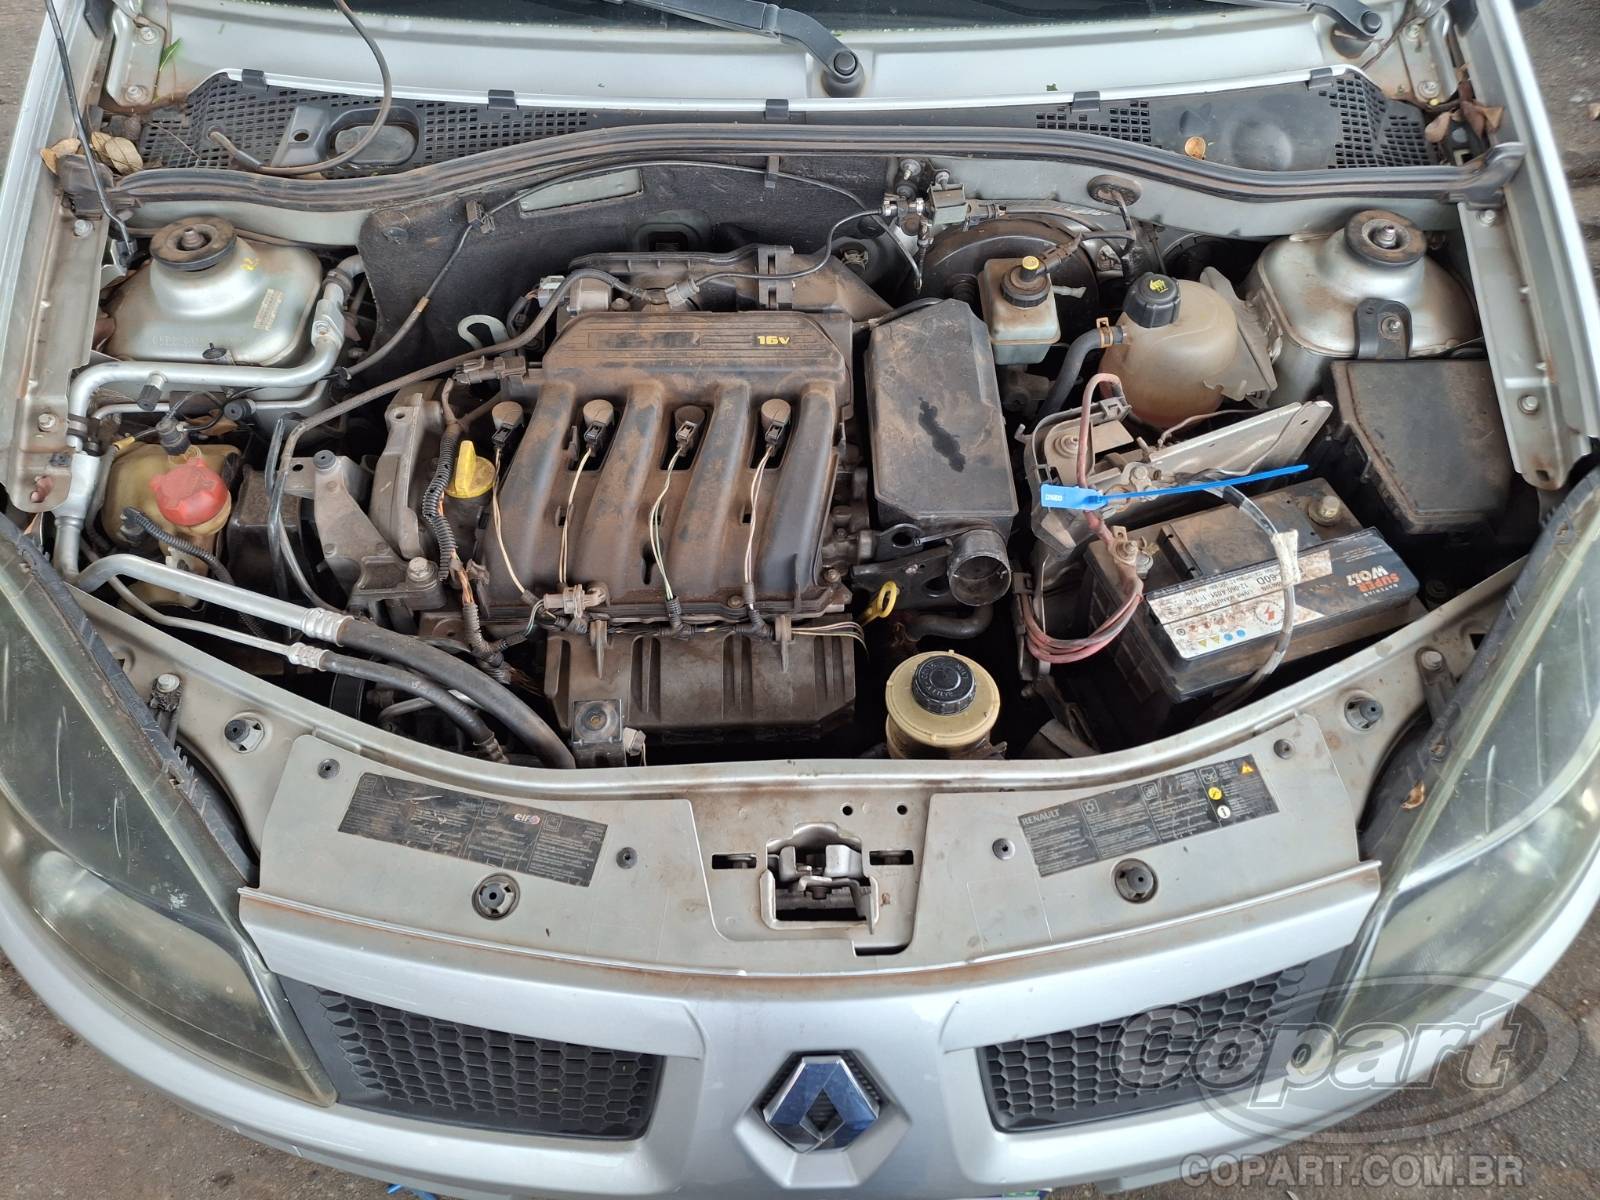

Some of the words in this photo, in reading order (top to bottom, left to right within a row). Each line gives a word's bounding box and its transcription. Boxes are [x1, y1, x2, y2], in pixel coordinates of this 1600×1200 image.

[1346, 565, 1389, 586] WOLT
[1360, 573, 1400, 592] SUPER
[514, 813, 531, 823] elf
[1022, 808, 1060, 825] RENAULT
